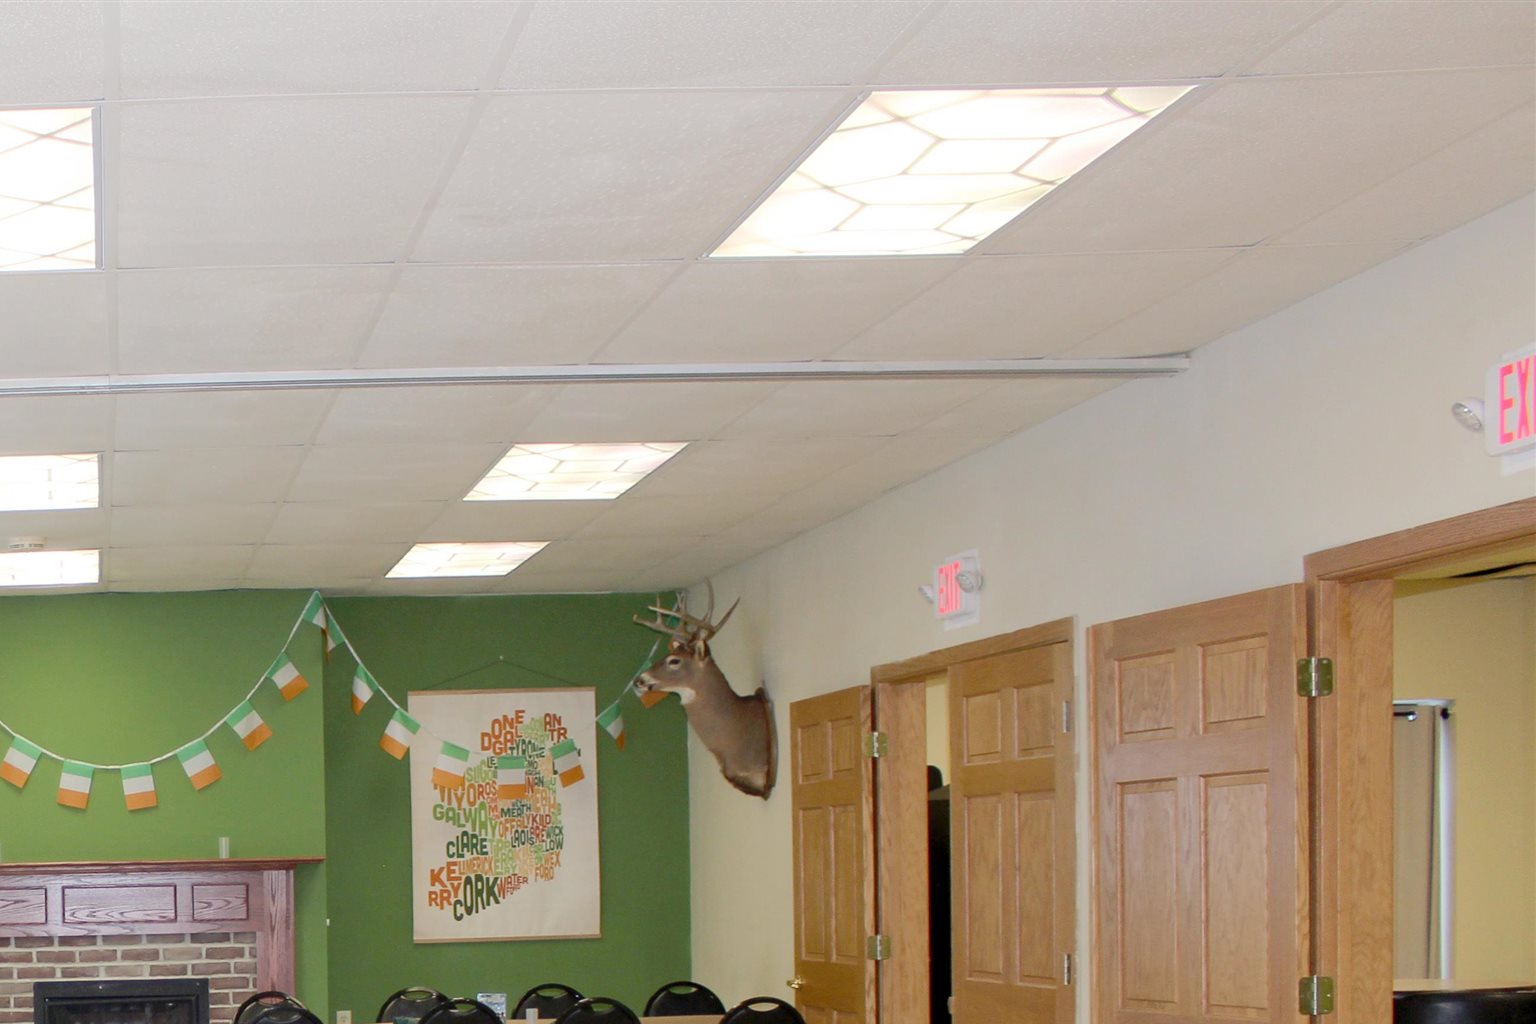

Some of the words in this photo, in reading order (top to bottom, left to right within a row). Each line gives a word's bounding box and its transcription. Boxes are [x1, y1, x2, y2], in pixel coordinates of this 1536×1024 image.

[432, 801, 499, 838] GALWAY
[446, 831, 489, 858] CLARE
[511, 829, 535, 848] LAOIS
[453, 873, 501, 922] CORK
